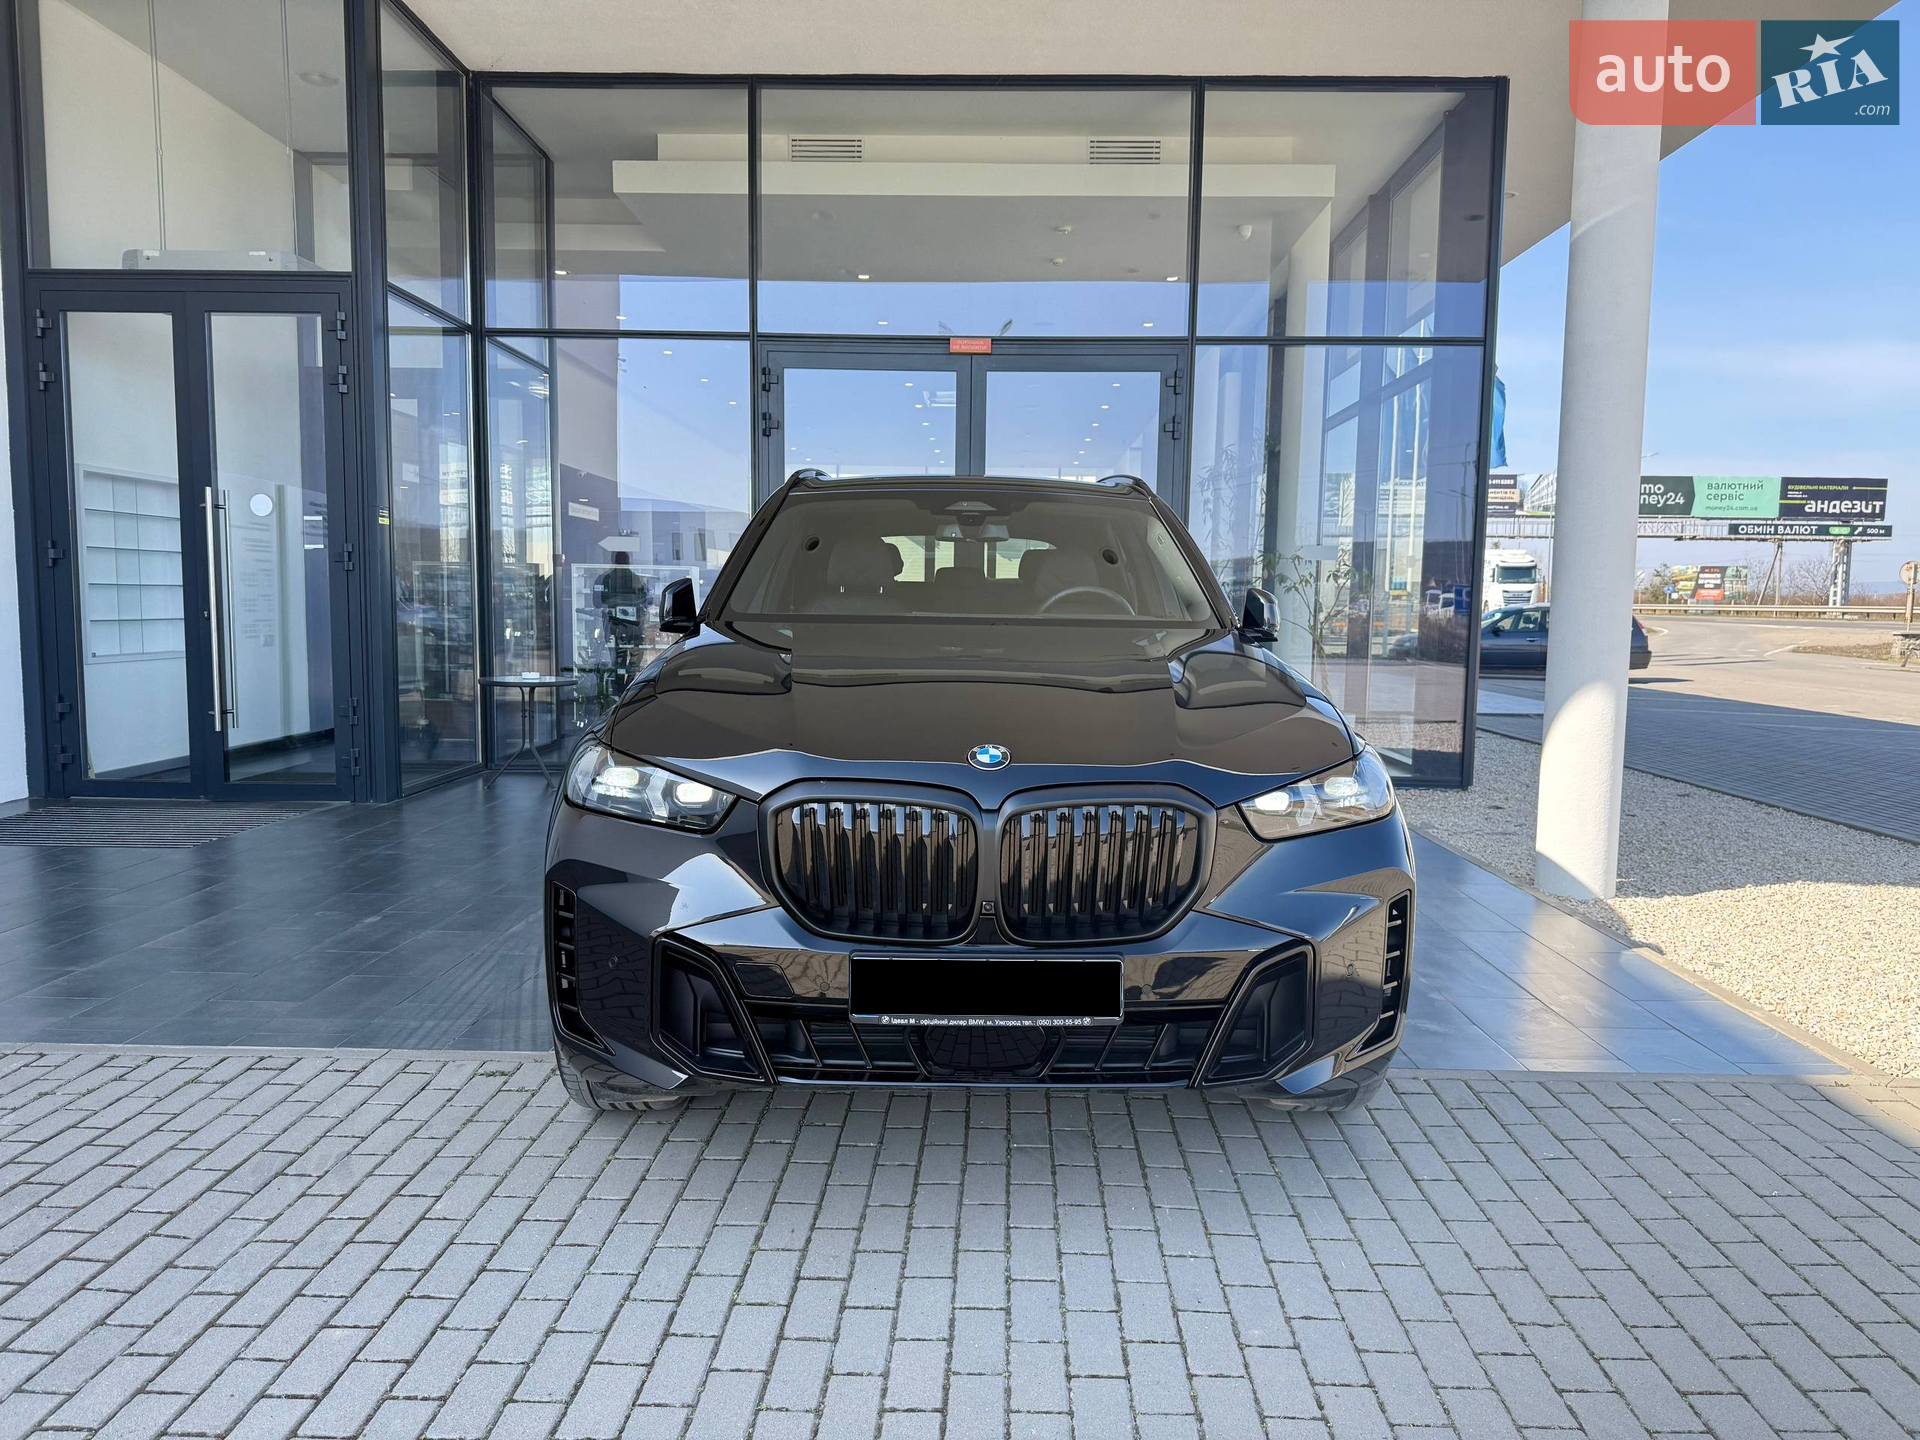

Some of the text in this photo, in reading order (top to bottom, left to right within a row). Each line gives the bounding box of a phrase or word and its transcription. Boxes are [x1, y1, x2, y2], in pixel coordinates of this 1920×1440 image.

[1640, 483, 1664, 494] mo
[1707, 480, 1764, 490] валютний
[1639, 492, 1685, 507] ney24
[1706, 490, 1744, 502] сервіс
[1804, 500, 1884, 514] андезит
[1738, 525, 1774, 534] ОБМІН
[1777, 526, 1818, 534] ВАЛЮТ
